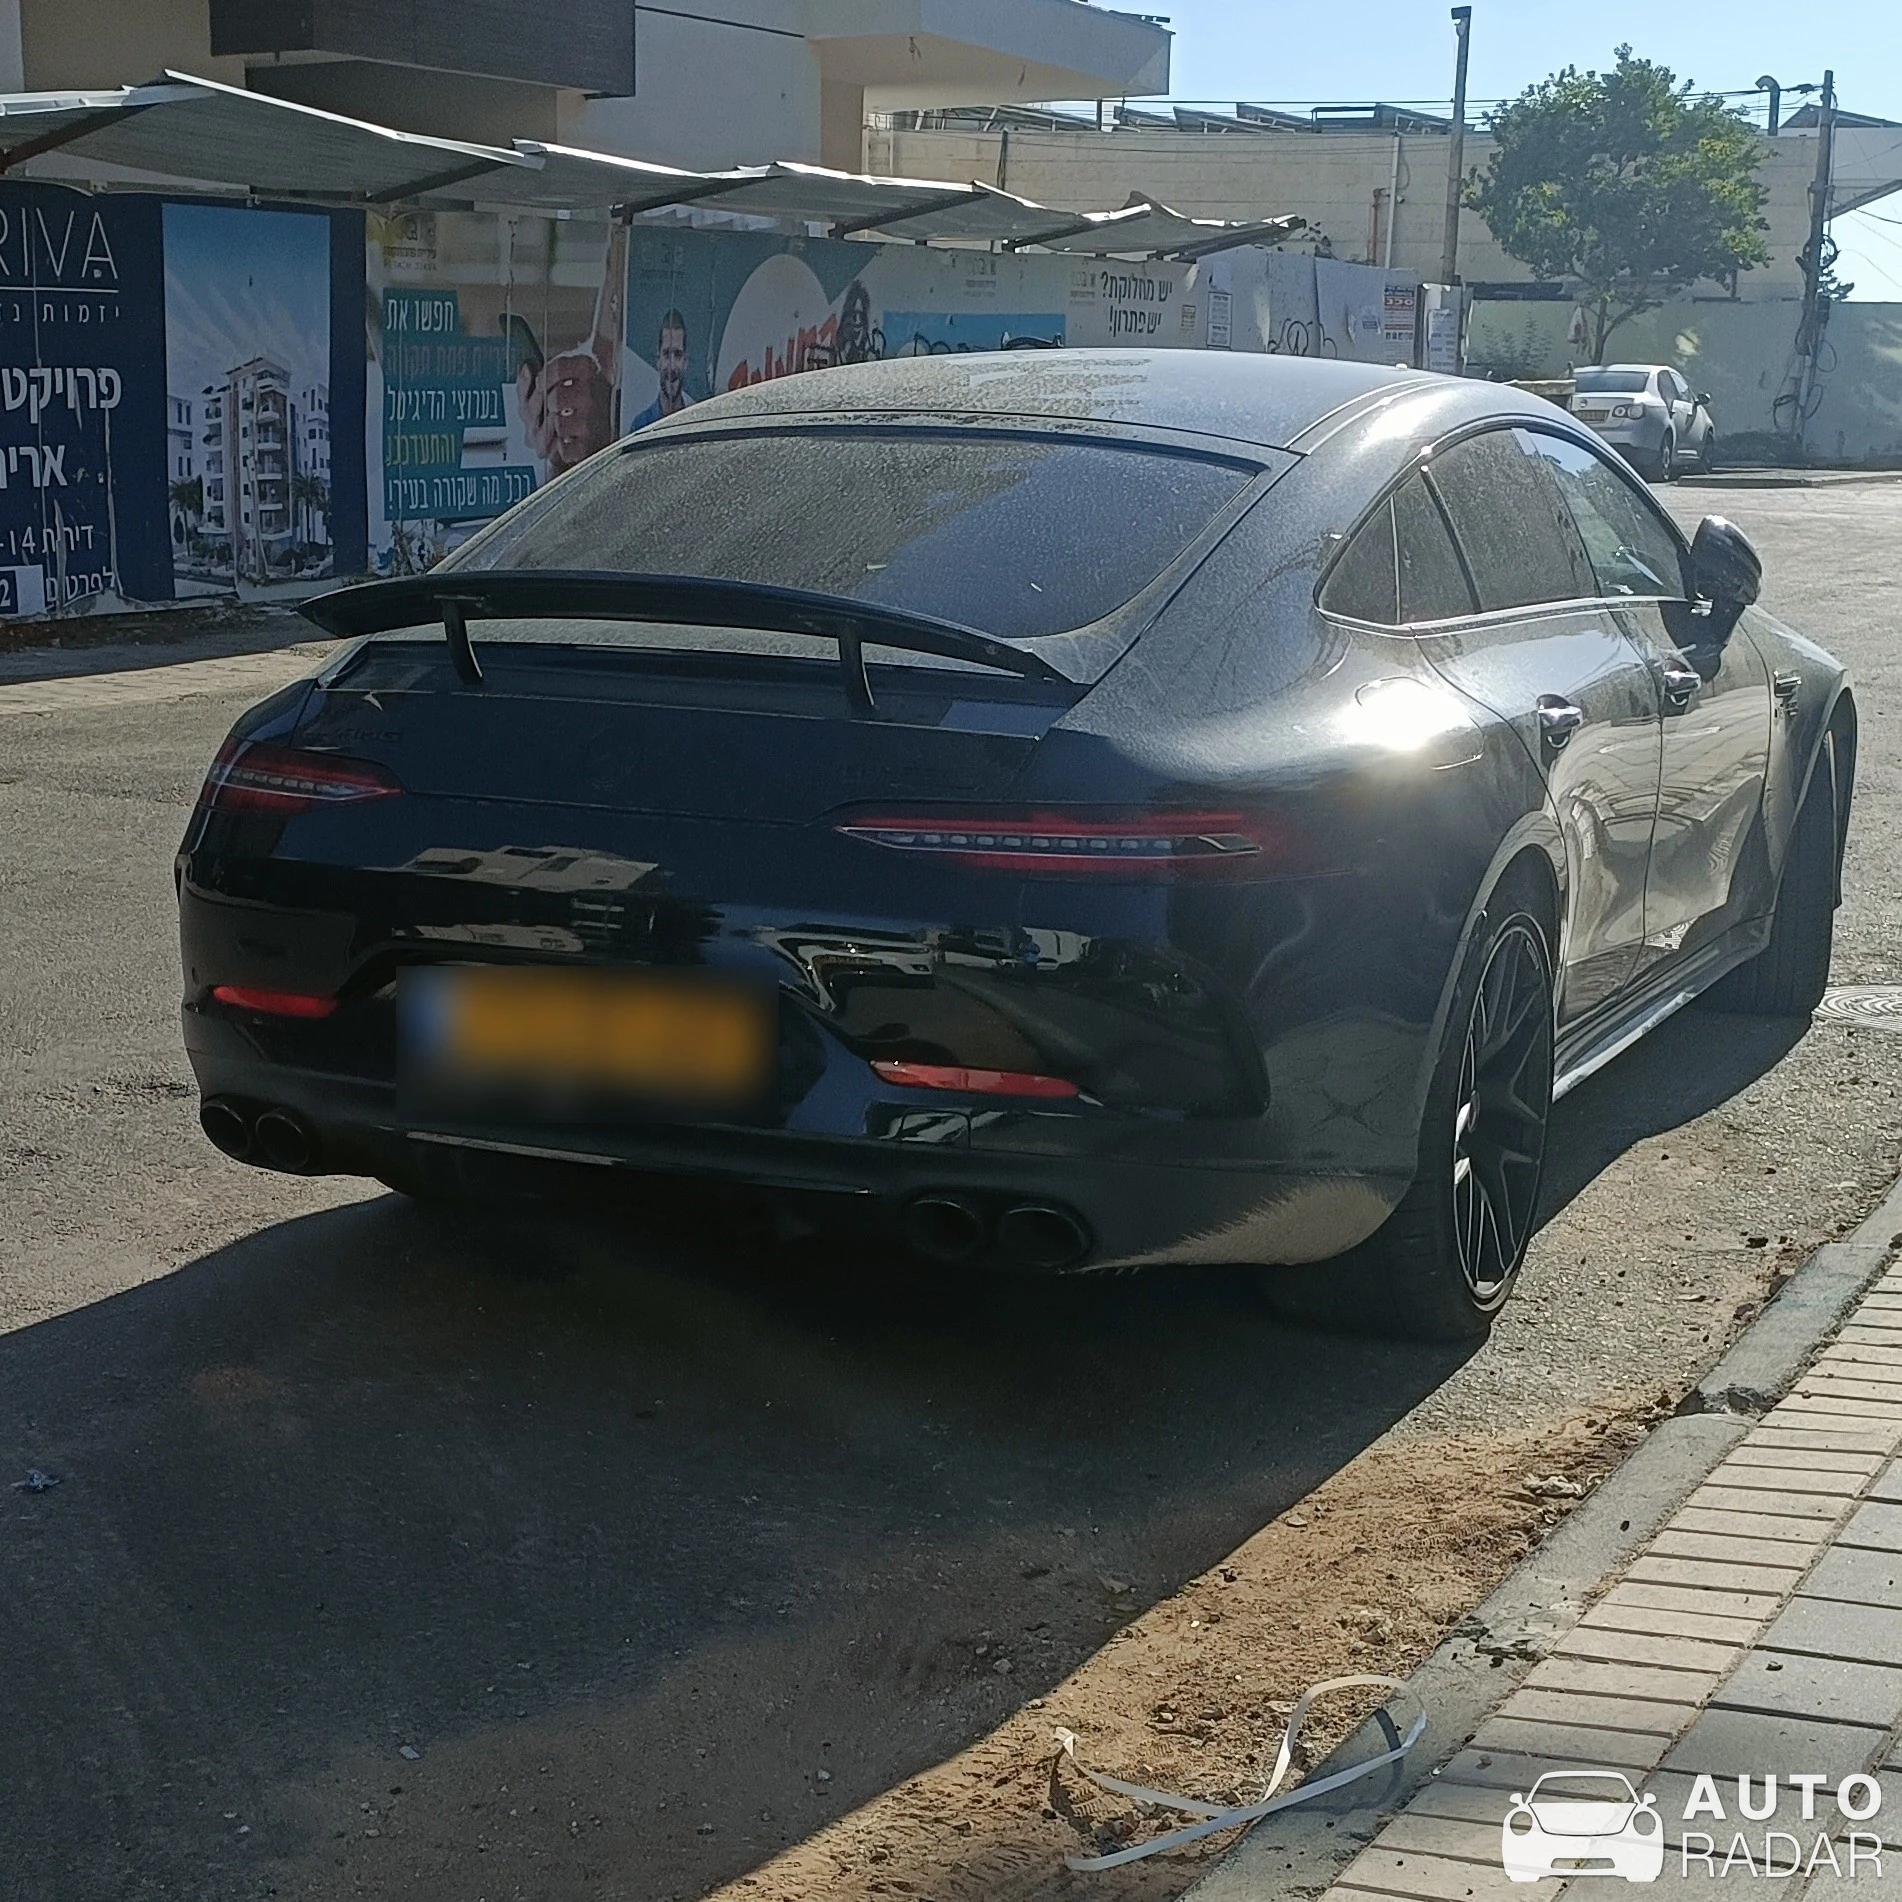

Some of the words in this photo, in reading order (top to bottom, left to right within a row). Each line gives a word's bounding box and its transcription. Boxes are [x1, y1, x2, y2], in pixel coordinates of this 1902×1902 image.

[1099, 271, 1155, 304] מחלוקת?
[1159, 279, 1173, 302] יש
[42, 303, 120, 323] יזמות
[386, 298, 409, 332] את
[414, 299, 454, 332] חפשו
[1109, 305, 1146, 338] פתרון!
[1147, 311, 1162, 334] יש
[1, 367, 122, 425] פרויקט
[451, 389, 499, 421] בערוצי
[388, 478, 429, 510] בעיר!
[433, 476, 477, 512] שקורה
[482, 475, 500, 506] מה
[46, 565, 115, 602] לפרטם
